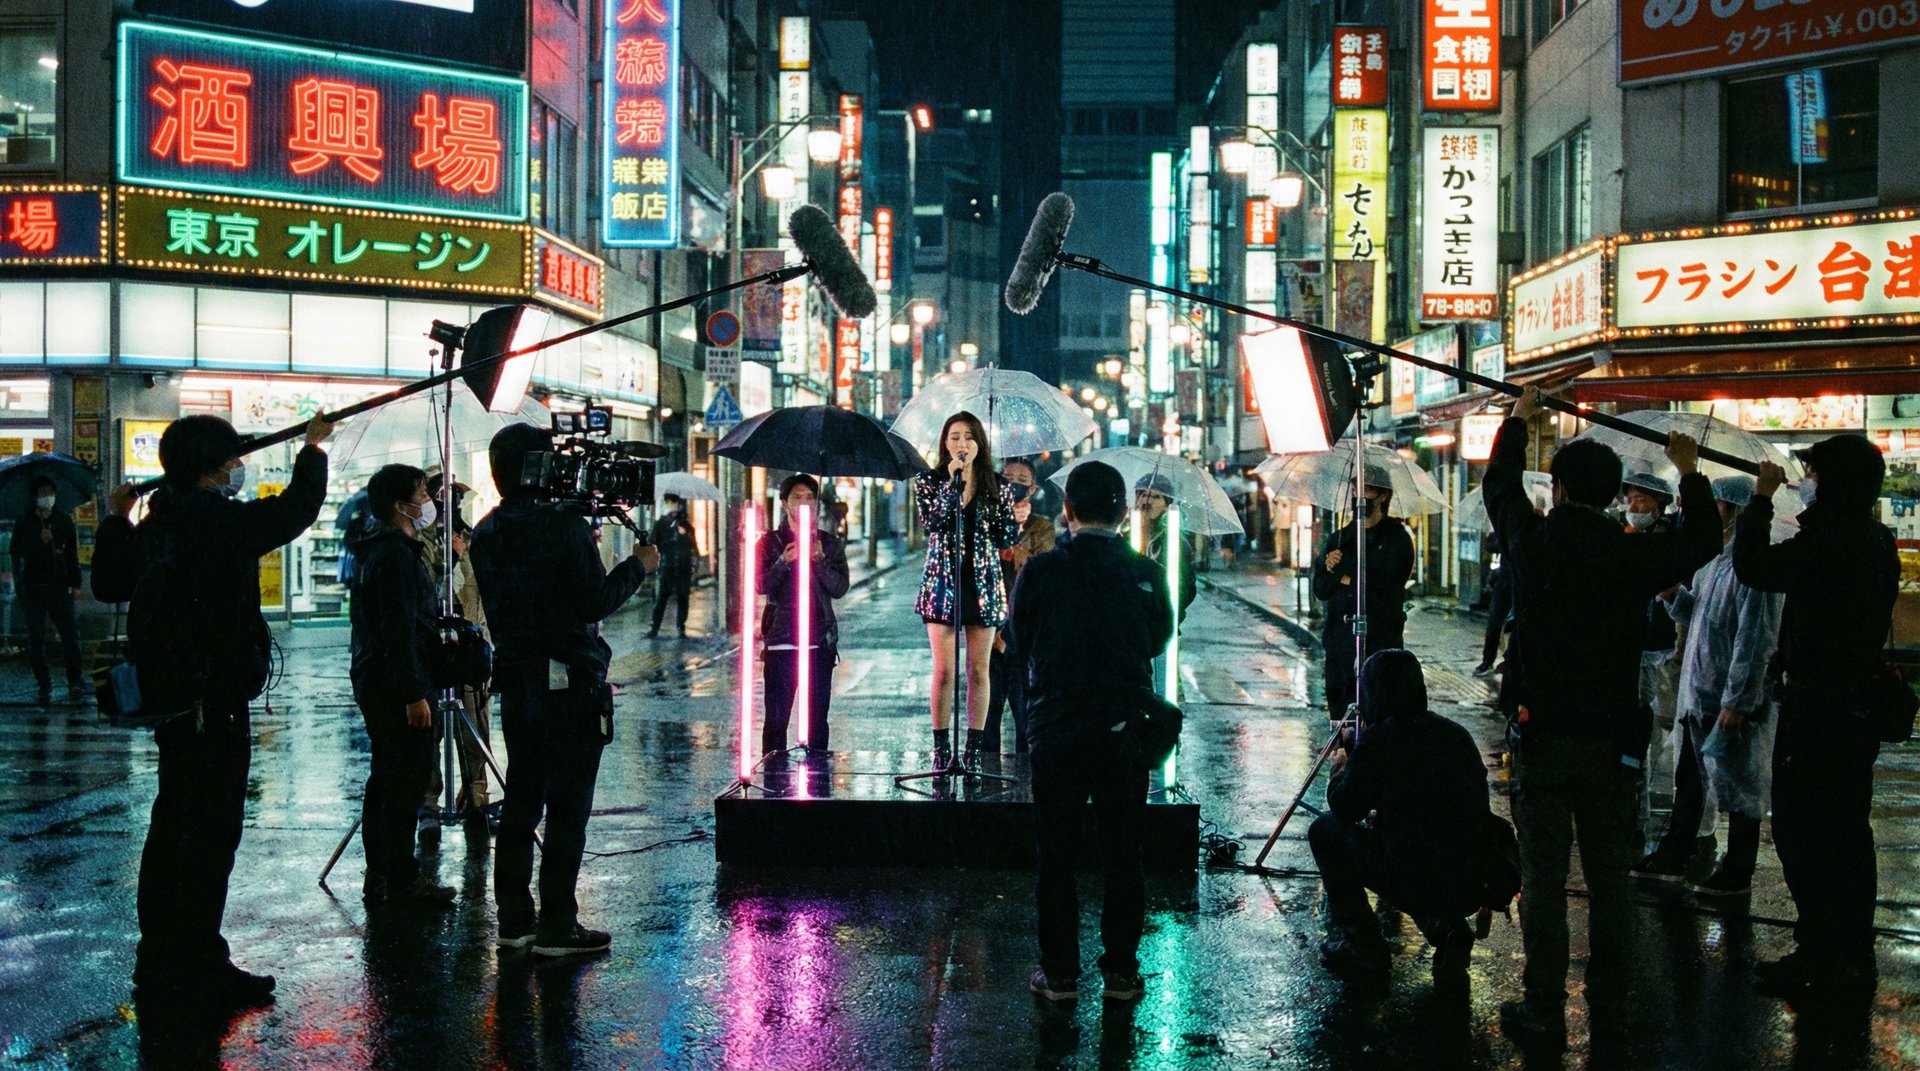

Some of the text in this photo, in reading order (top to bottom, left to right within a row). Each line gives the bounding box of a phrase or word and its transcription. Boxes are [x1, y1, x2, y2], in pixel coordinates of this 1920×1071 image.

[152, 59, 501, 194] 酒興場
[9, 201, 57, 250] 場
[611, 191, 668, 220] 飯店
[166, 208, 491, 272] 東京 オレージン
[1635, 259, 1798, 304] フラシン
